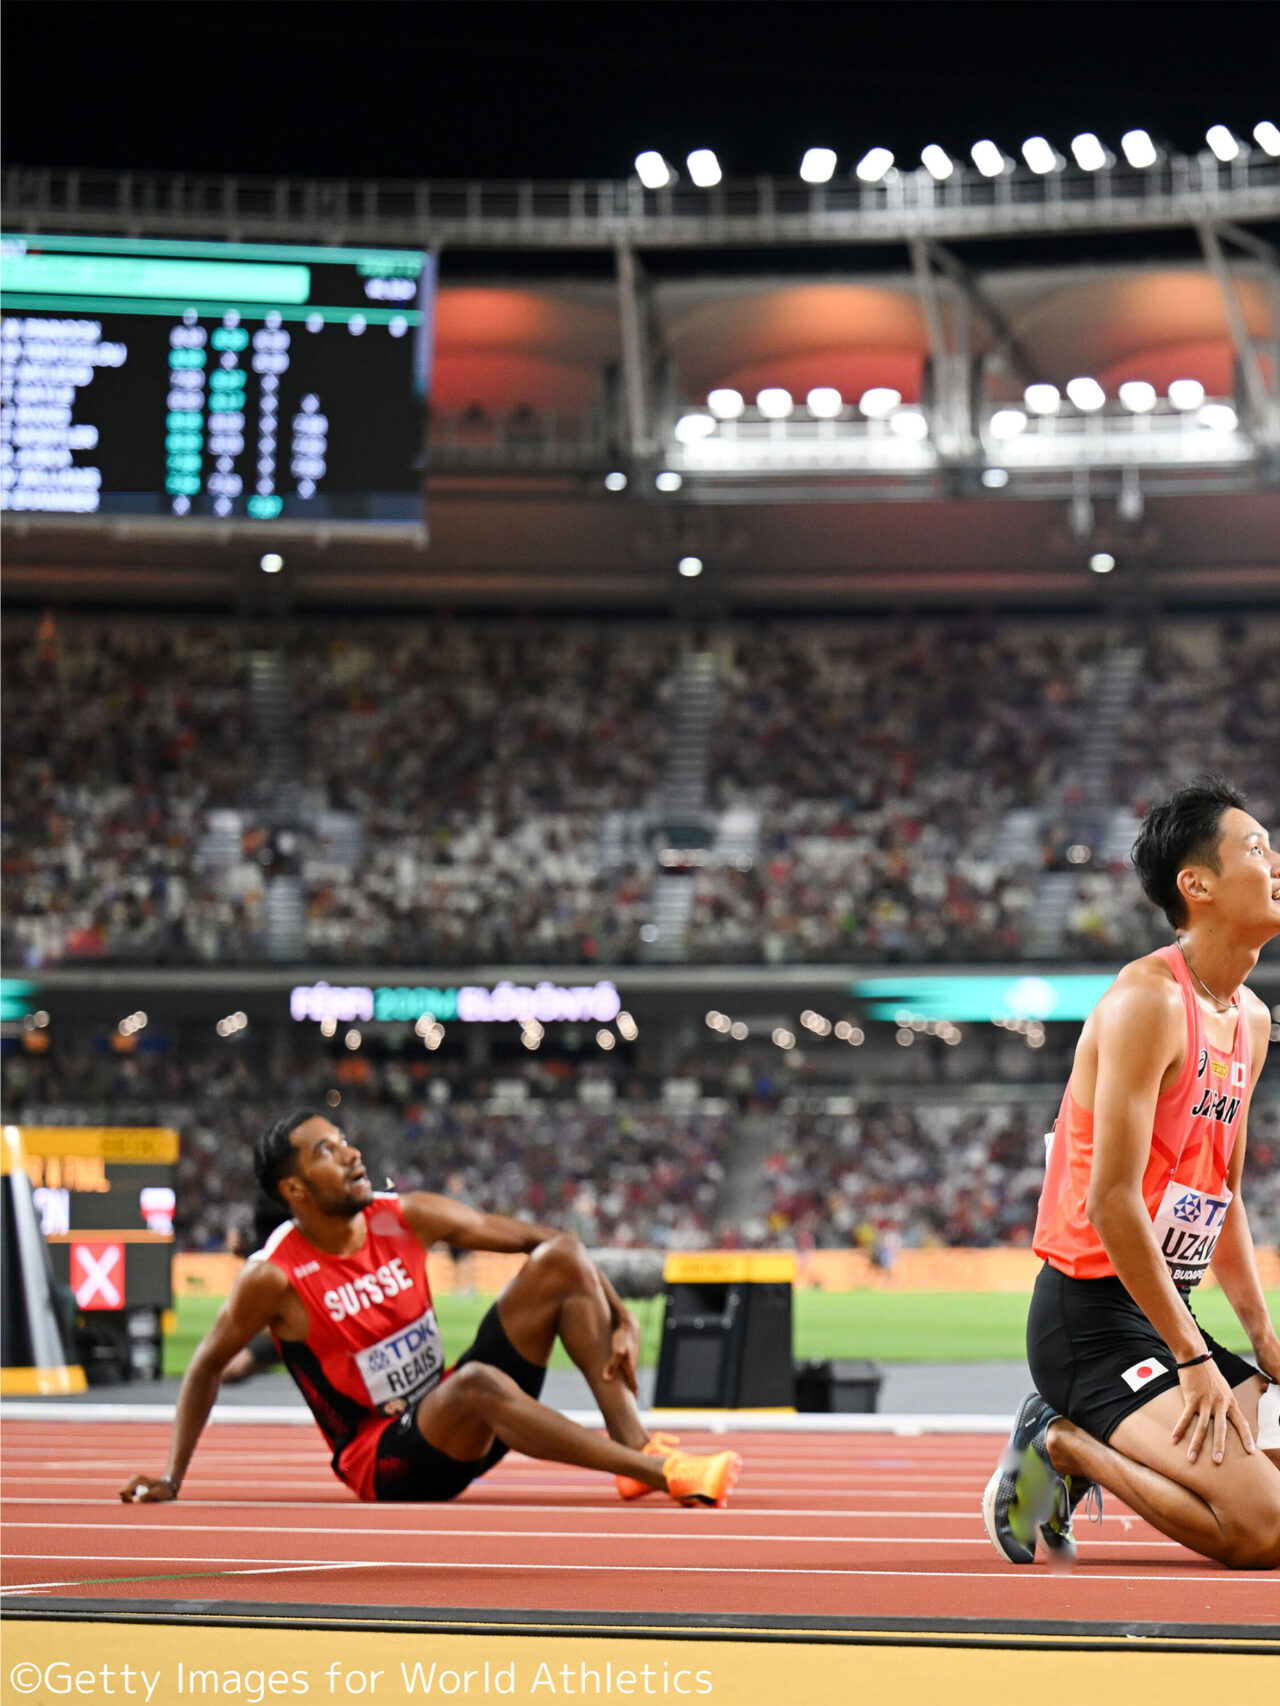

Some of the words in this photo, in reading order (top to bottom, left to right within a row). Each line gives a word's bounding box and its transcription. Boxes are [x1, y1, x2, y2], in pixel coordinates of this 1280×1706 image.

[1205, 1199, 1227, 1226] T
[323, 1257, 414, 1322] SUISSE
[385, 1321, 435, 1360] TDK
[387, 1346, 437, 1392] REAIS
